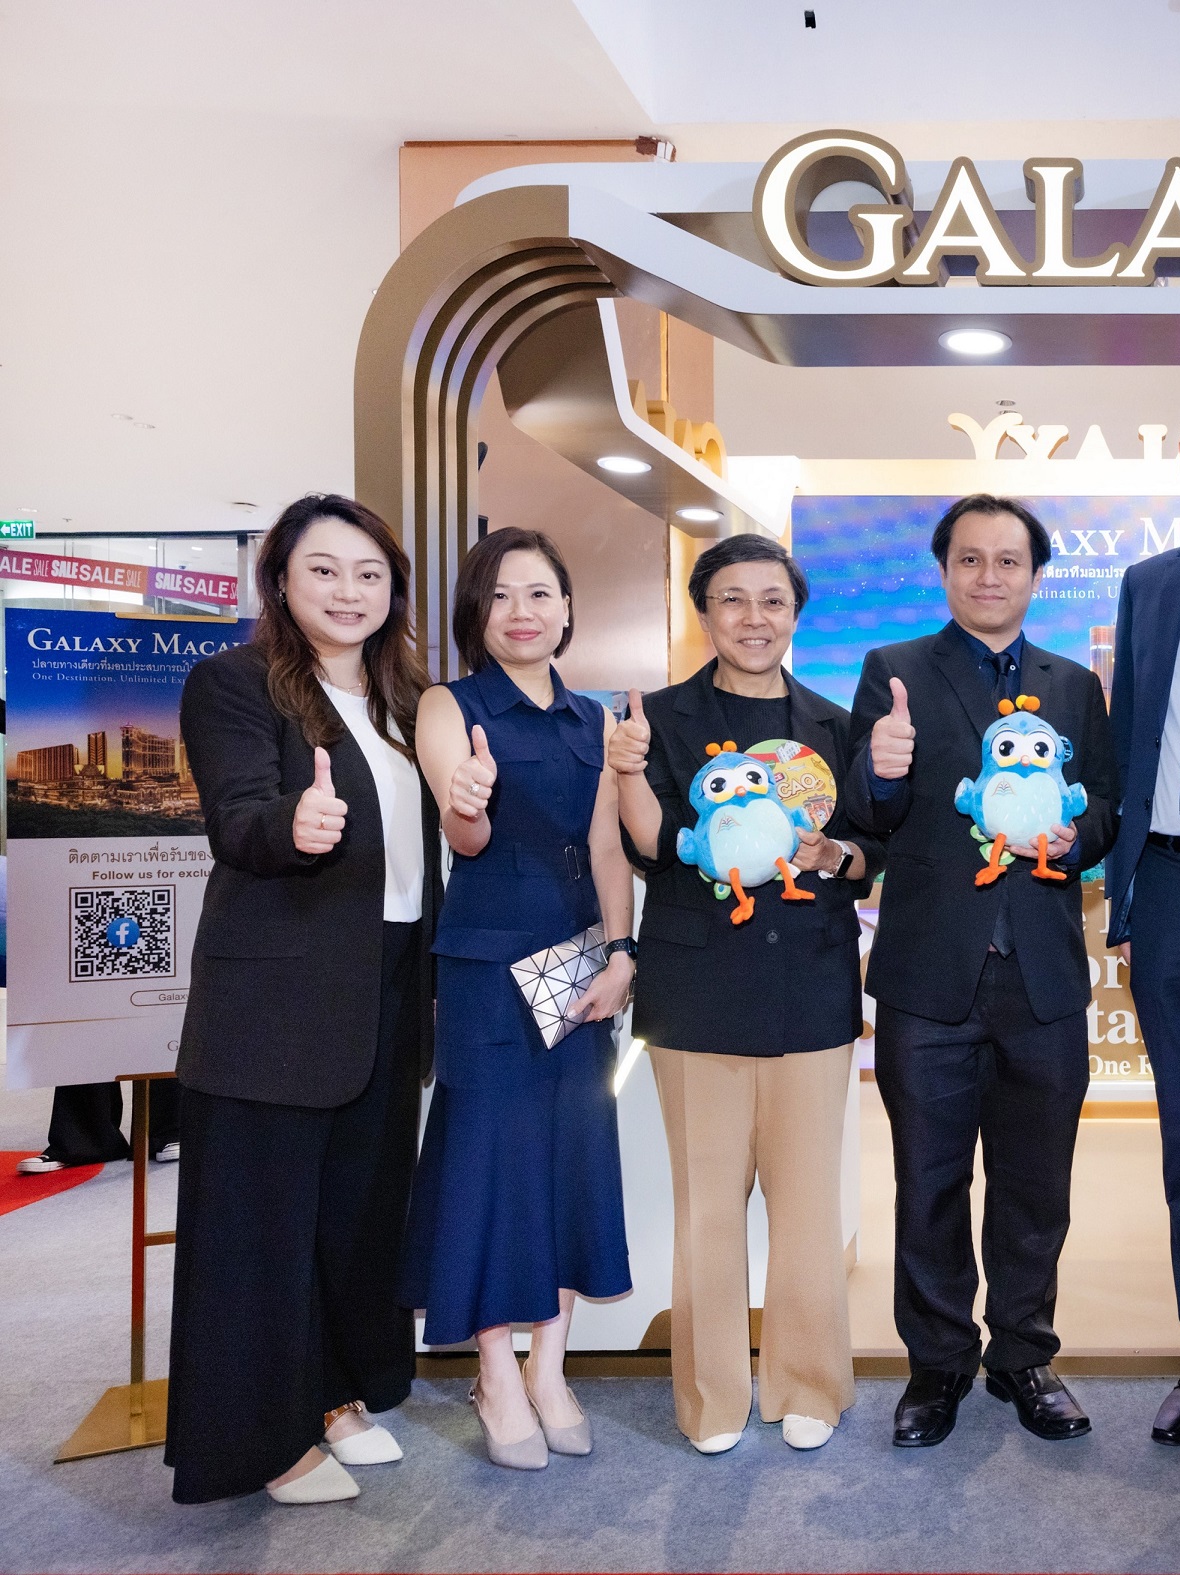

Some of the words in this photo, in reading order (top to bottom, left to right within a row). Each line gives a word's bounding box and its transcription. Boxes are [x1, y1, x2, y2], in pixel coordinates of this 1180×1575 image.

[10, 523, 32, 537] EXIT
[1050, 529, 1124, 556] AXY
[0, 556, 32, 575] ALE
[33, 559, 49, 577] SALE
[51, 560, 78, 579] SALE
[79, 564, 124, 586] SALE
[125, 570, 141, 588] SALE
[155, 572, 182, 592] SALE
[182, 579, 229, 598] SALE
[1032, 586, 1100, 600] stination,
[27, 627, 142, 654] GALAXY
[32, 672, 53, 681] One
[120, 675, 167, 684] Unlimited
[776, 773, 816, 798] CAO
[92, 870, 134, 881] Follow
[157, 869, 174, 878] for
[179, 868, 211, 879] exclu
